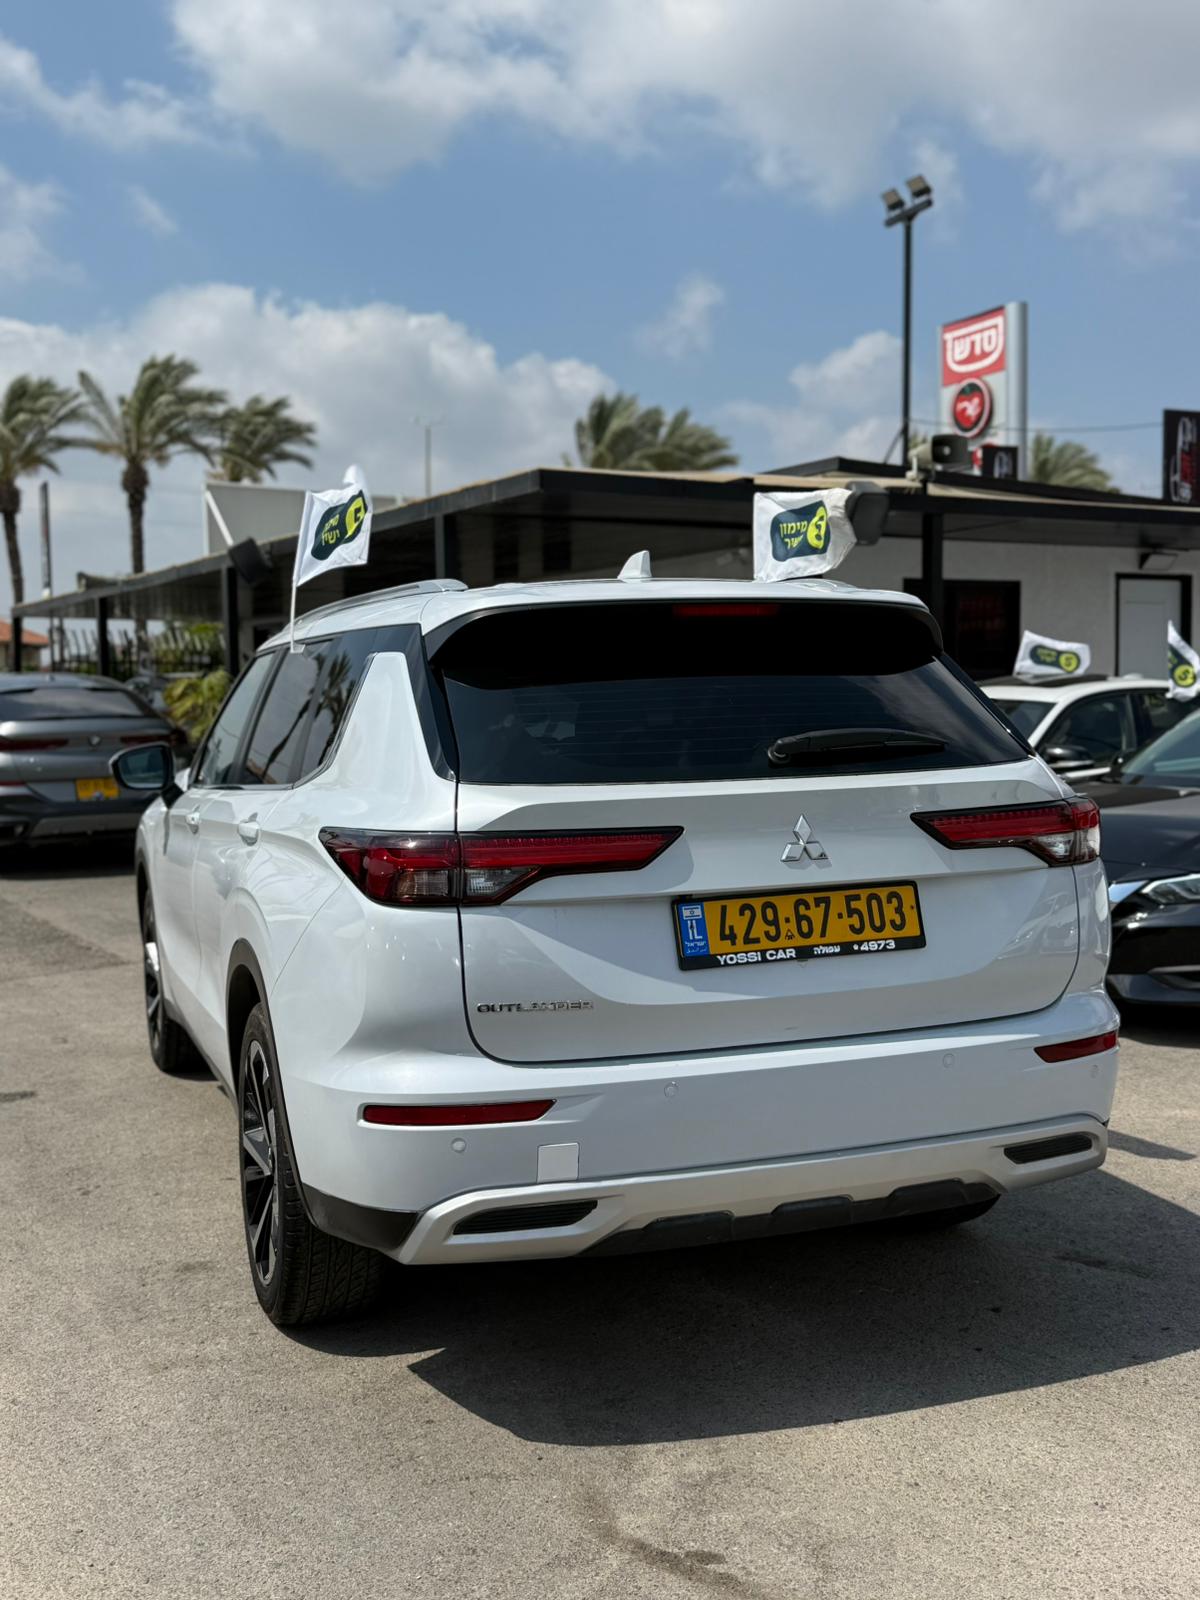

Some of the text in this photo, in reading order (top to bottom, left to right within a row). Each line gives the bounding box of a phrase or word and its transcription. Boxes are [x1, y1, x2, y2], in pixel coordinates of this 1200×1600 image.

[779, 520, 808, 538] מימון
[687, 919, 703, 940] IL
[716, 948, 796, 965] YOSSI CAR
[813, 944, 841, 955] עפולה
